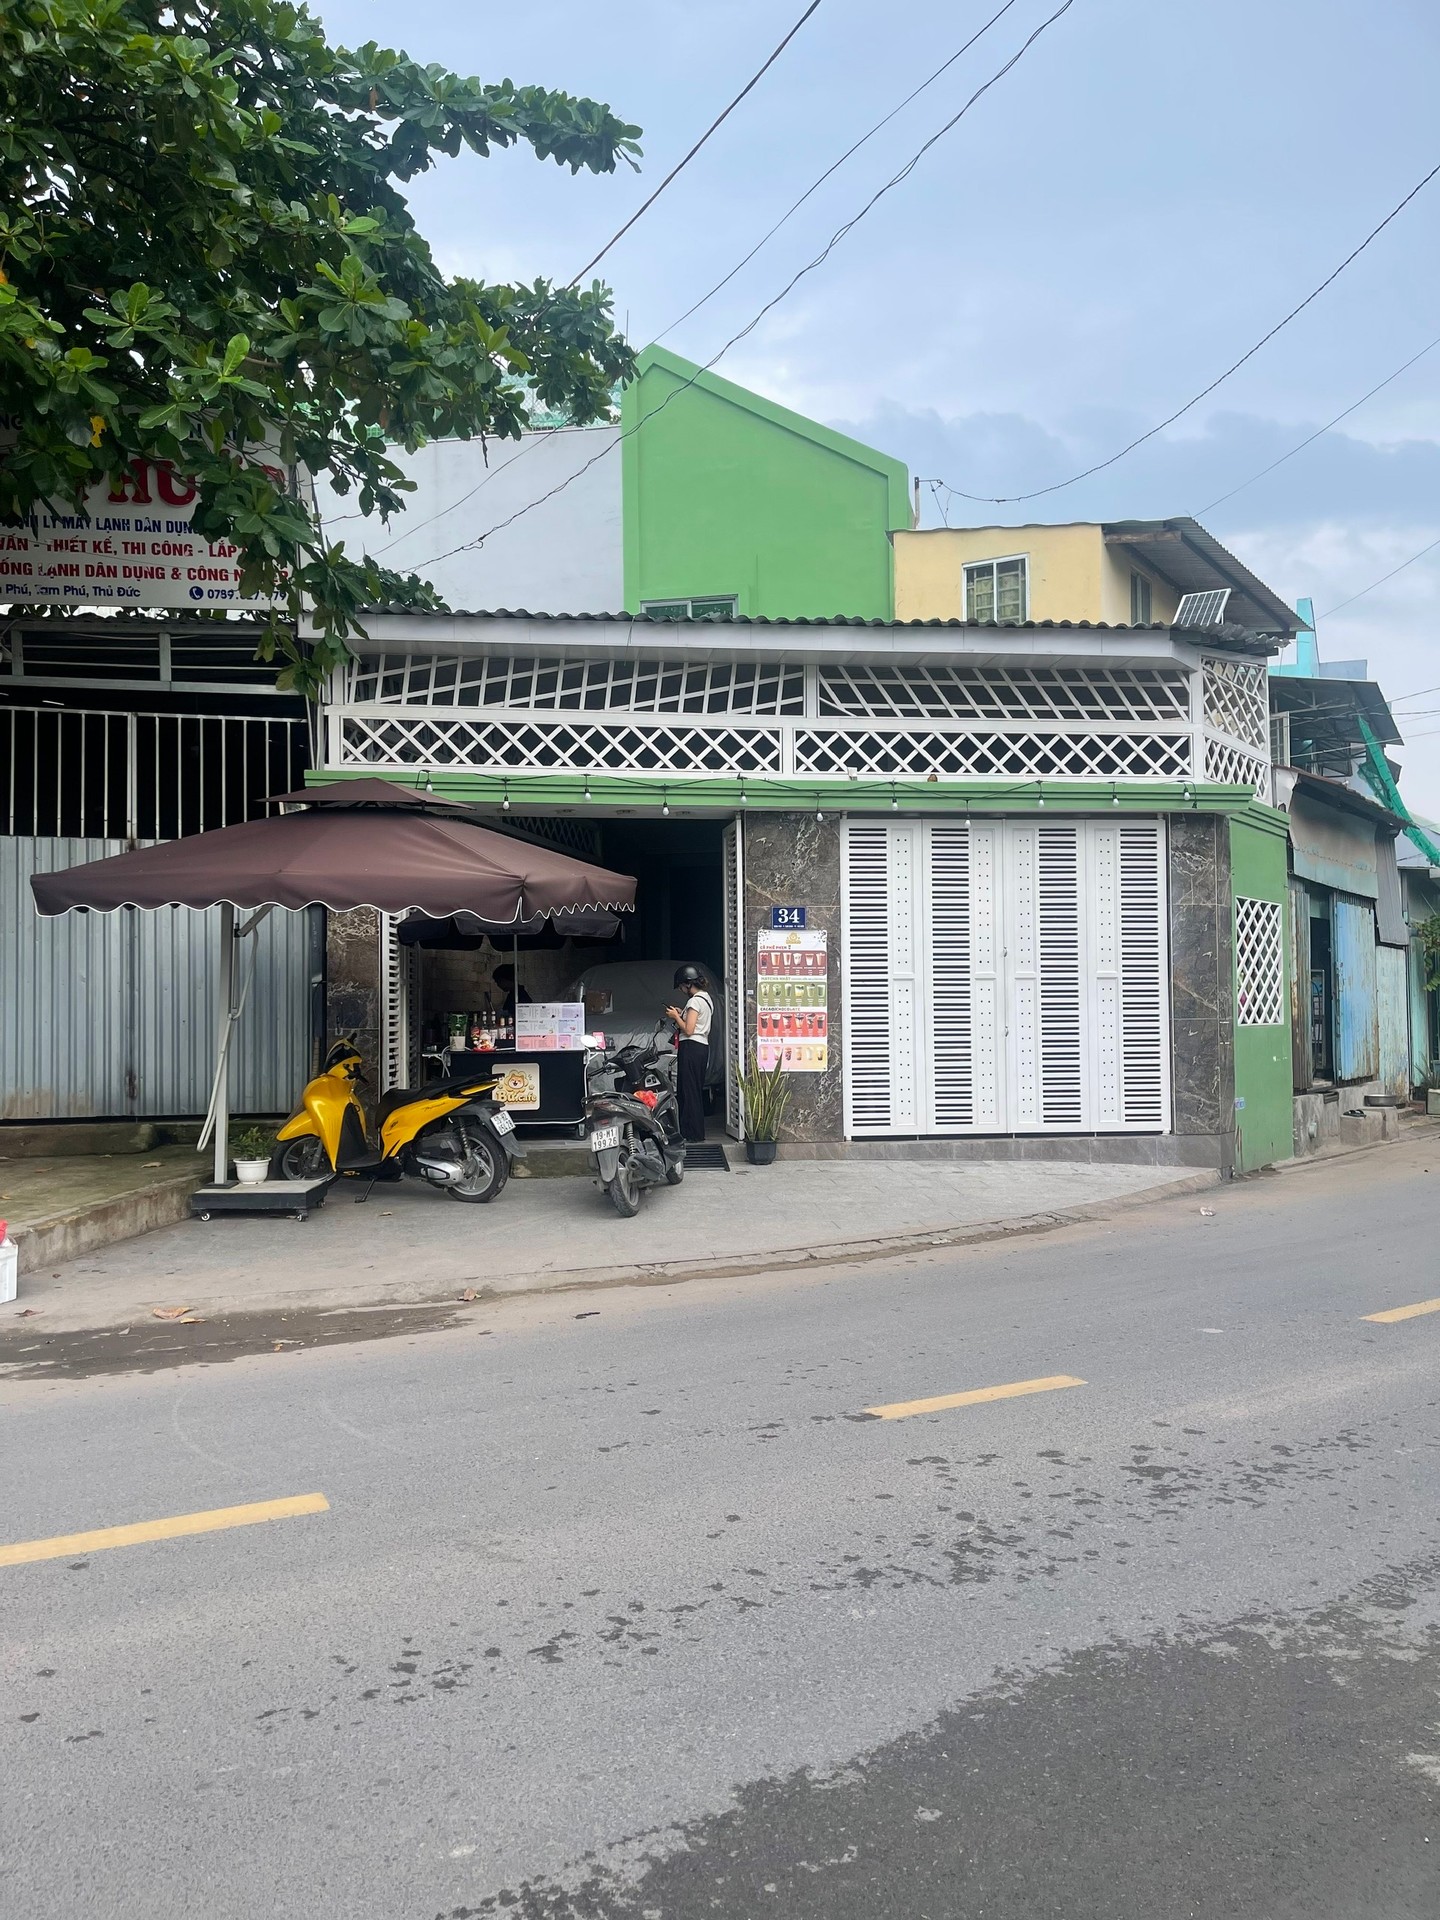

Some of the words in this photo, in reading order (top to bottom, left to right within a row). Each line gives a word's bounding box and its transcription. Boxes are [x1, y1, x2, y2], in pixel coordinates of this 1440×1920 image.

[96, 517, 131, 533] LẠNH
[134, 517, 161, 533] DÂN
[93, 536, 117, 555] KẾ,
[122, 541, 146, 555] THI
[151, 540, 193, 557] CÔNG
[85, 561, 118, 578] DÂN
[122, 565, 166, 582] DỤNG
[170, 567, 183, 581] &
[187, 565, 229, 582] CÔNG
[63, 584, 90, 598] Phú,
[92, 584, 113, 597] Thủ
[117, 585, 141, 598] Đức
[778, 908, 800, 924] 34
